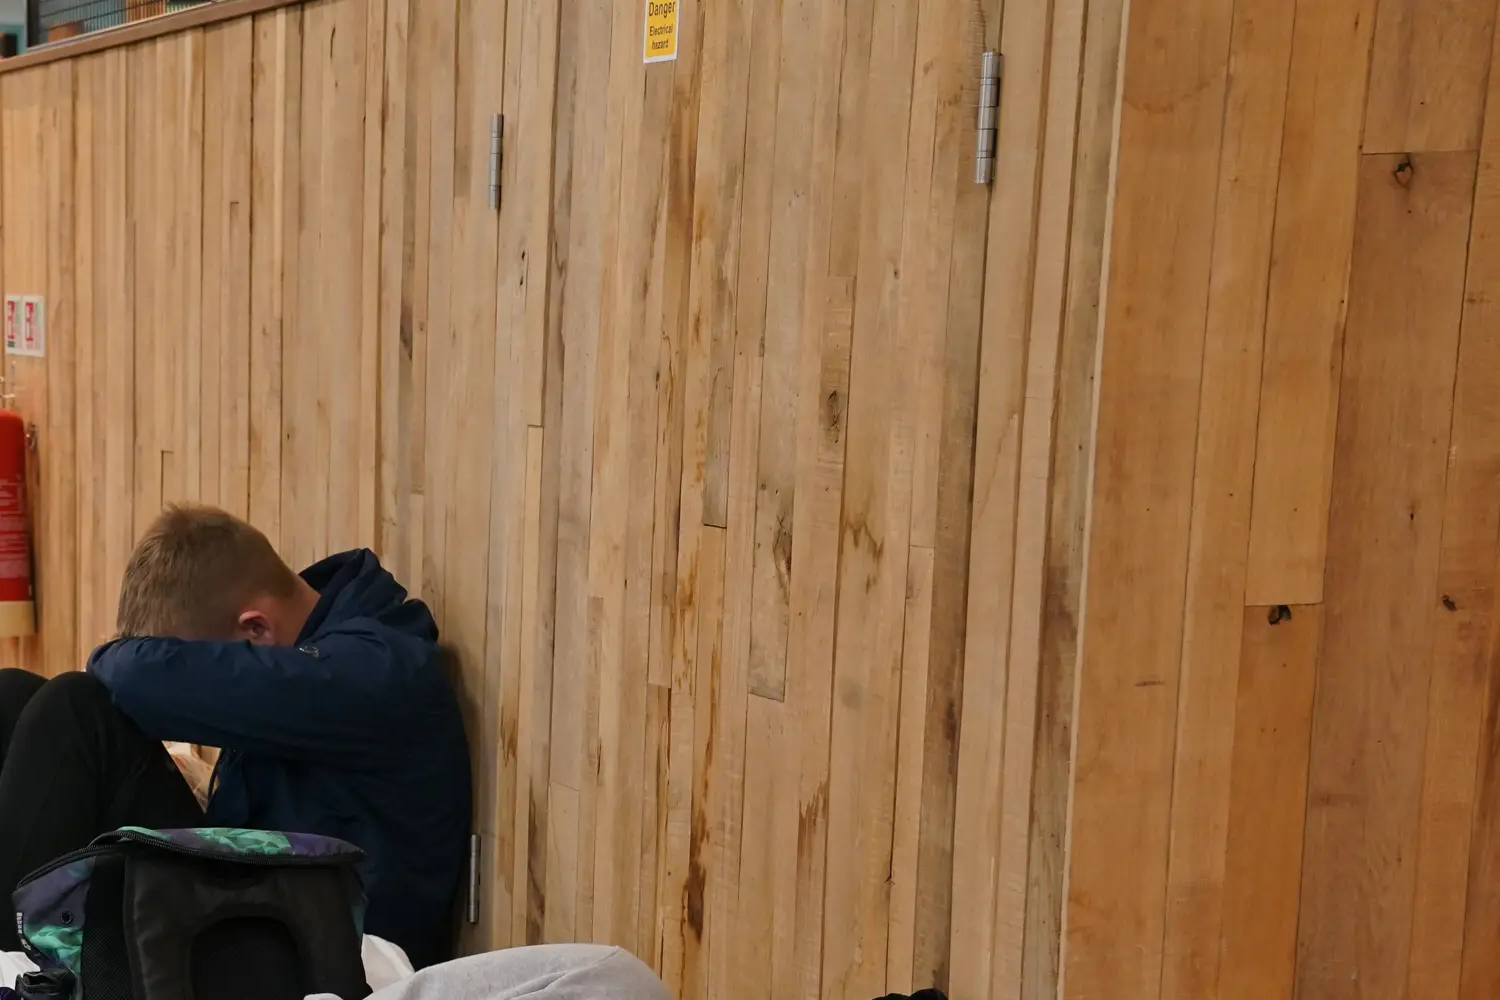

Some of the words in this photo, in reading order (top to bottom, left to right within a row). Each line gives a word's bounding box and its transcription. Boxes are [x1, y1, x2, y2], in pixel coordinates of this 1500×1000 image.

[649, 1, 675, 18] Danger
[649, 24, 673, 36] Electrical
[651, 39, 669, 50] hazard
